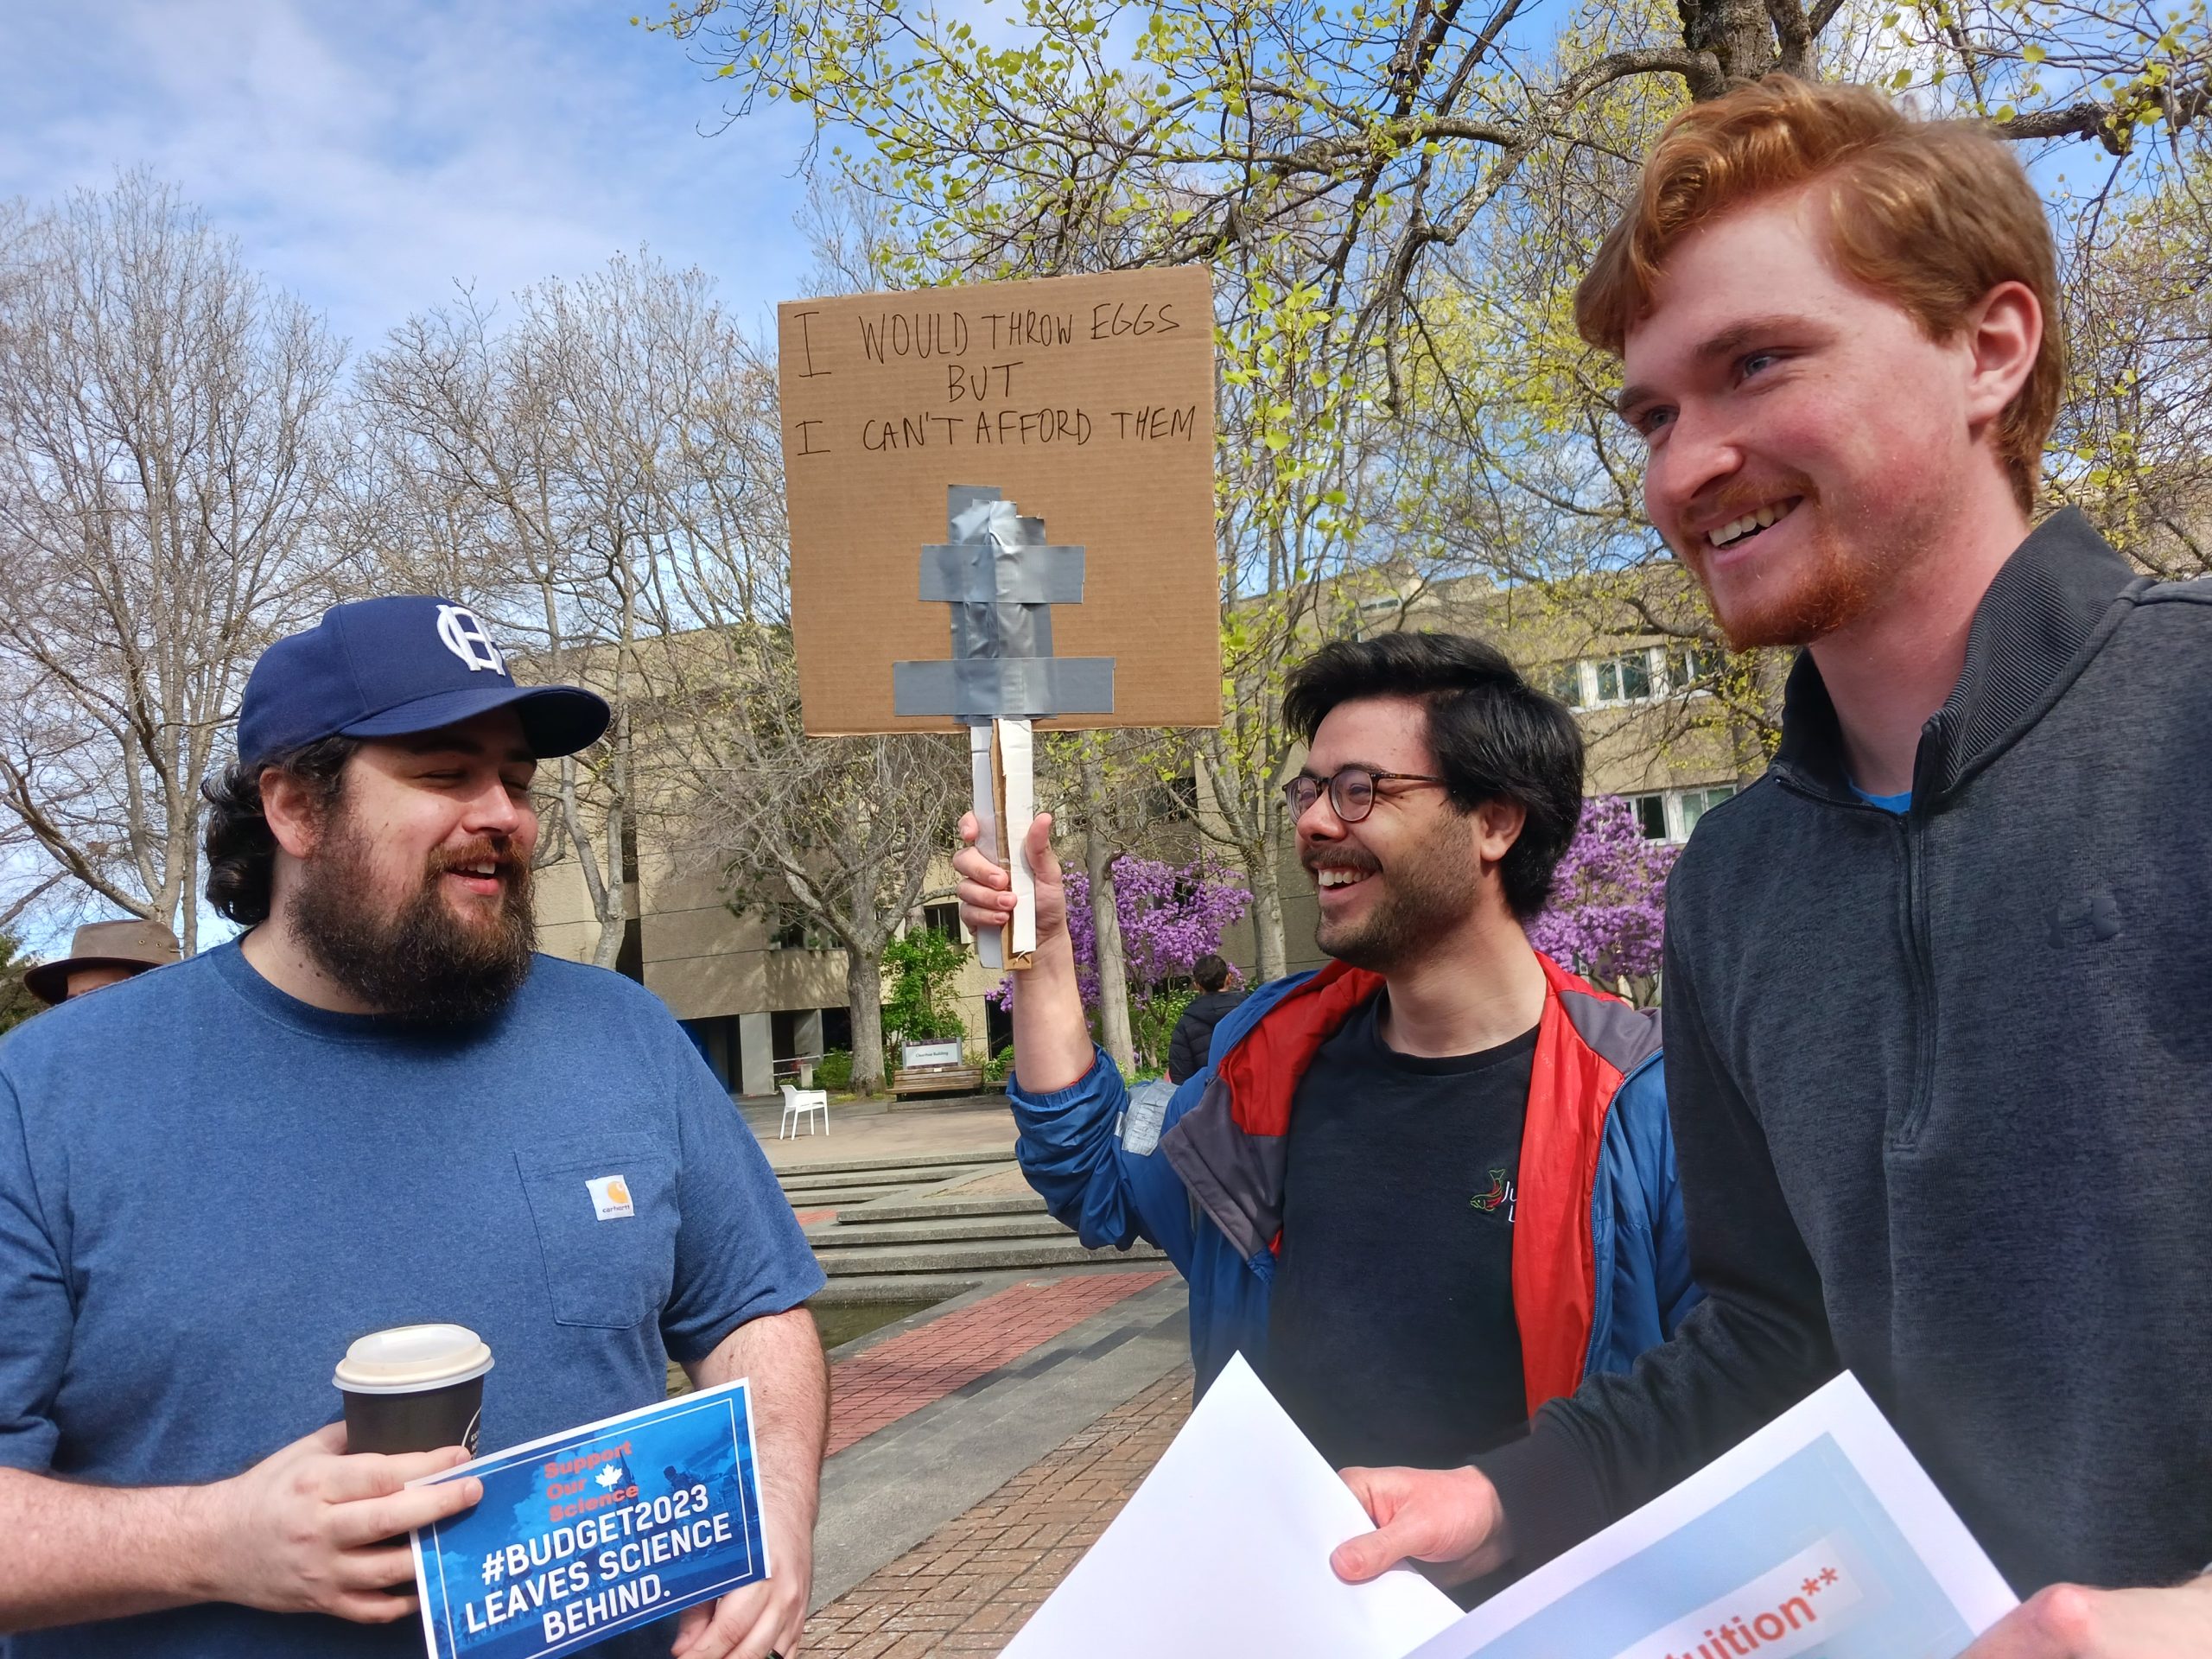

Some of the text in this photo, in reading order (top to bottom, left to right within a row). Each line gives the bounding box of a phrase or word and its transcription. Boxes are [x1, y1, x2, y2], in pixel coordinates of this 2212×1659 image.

[795, 302, 1180, 378] I WOULD THROW EGGS
[949, 361, 1023, 403] BUT
[795, 405, 1197, 456] I CAN'T AFFORD THEM
[544, 1440, 632, 1478] Support
[546, 1478, 588, 1500] Our
[549, 1484, 639, 1522] Science
[481, 1484, 709, 1586] #BUDGET2023
[465, 1512, 733, 1634] LEAVES SCIENCE
[543, 1573, 671, 1643] BEHIND.
